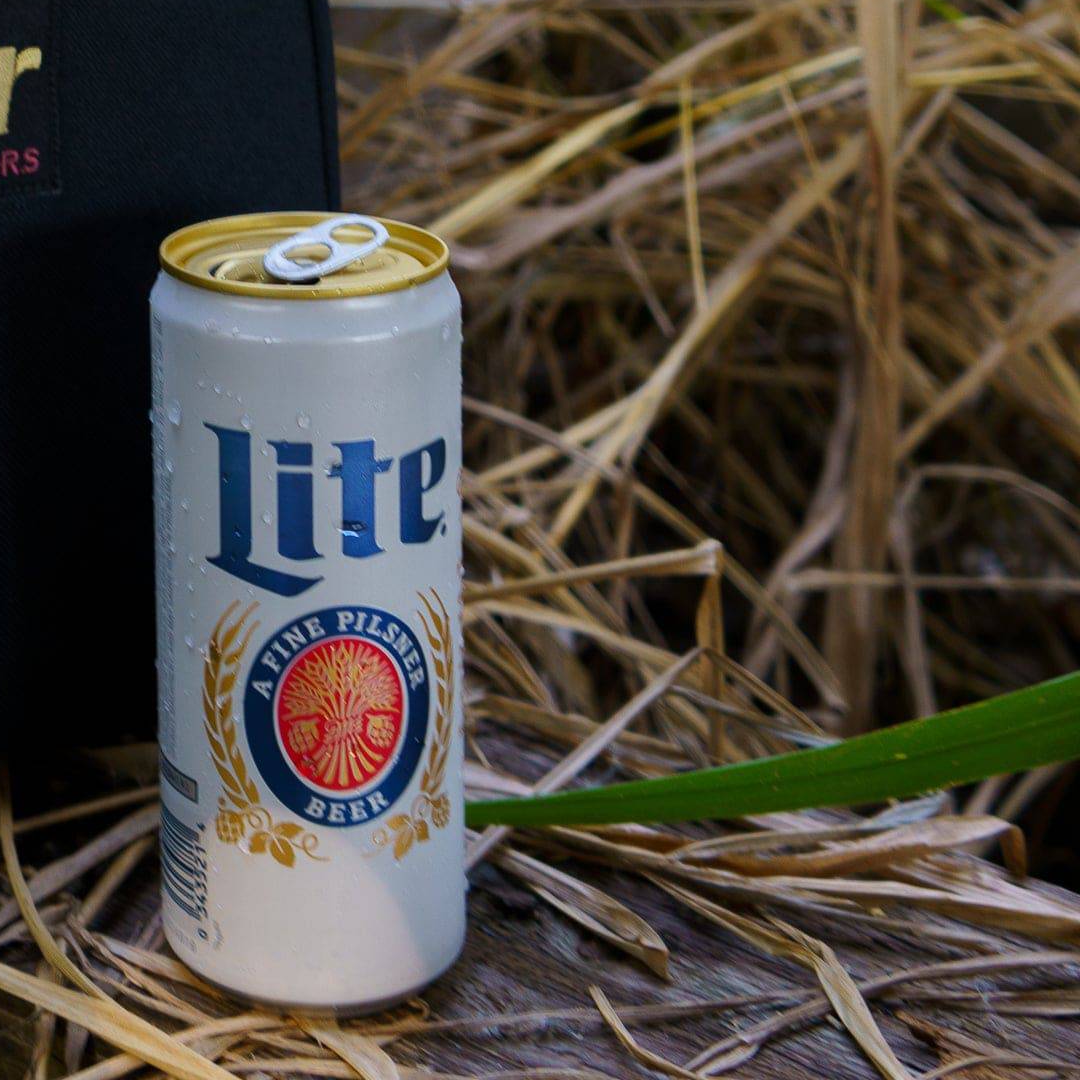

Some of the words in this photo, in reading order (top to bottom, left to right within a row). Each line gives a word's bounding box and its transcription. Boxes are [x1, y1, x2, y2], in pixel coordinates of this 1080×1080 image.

[202, 421, 446, 598] Lite
[260, 616, 326, 675] FINE
[336, 610, 425, 691] PILSNER
[251, 678, 274, 701] A
[304, 791, 390, 824] BEER
